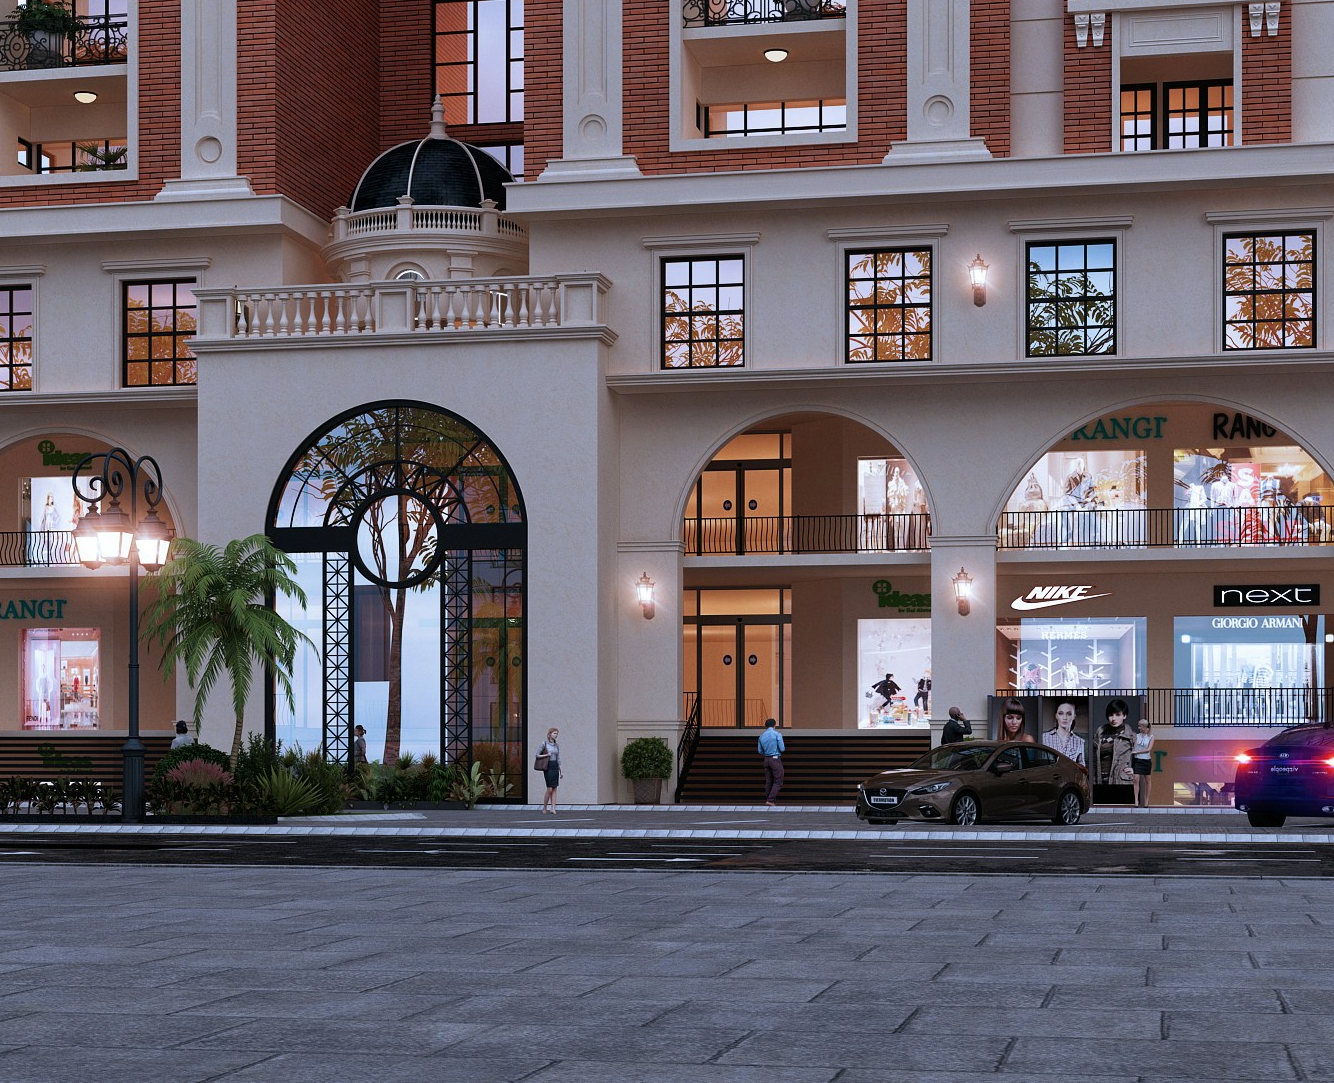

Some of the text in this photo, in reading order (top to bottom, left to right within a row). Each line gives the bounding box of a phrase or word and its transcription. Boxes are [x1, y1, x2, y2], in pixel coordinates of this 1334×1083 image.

[1025, 585, 1093, 600] NIKE
[1221, 587, 1312, 604] next
[1212, 618, 1303, 628] GIORGIO ARMANI
